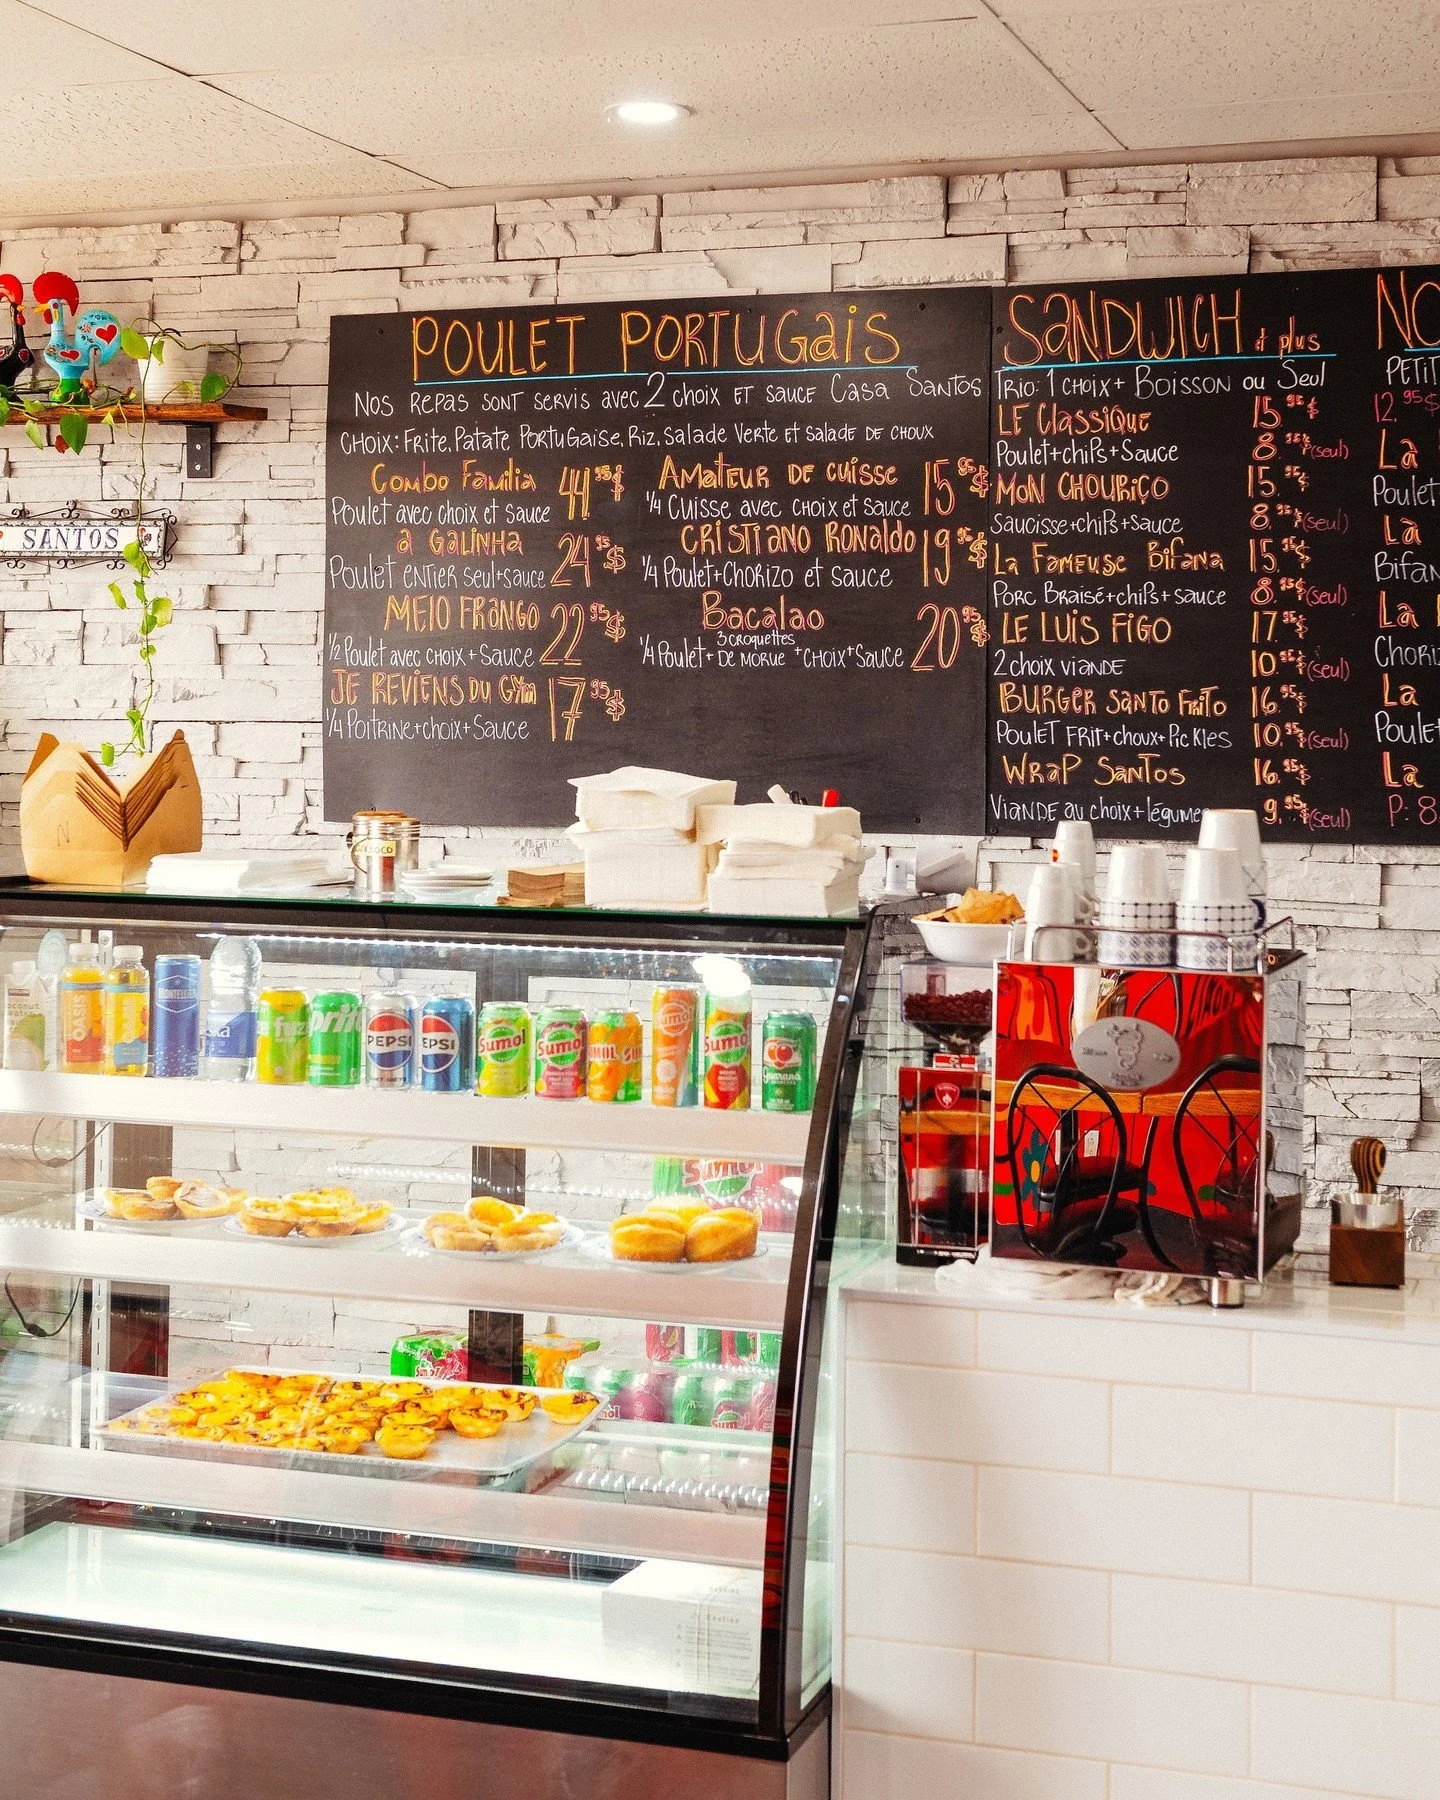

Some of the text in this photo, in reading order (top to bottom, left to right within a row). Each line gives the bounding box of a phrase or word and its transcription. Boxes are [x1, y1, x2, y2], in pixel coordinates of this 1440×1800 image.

[412, 315, 586, 381] POULET
[1279, 315, 1320, 360] plus
[601, 389, 639, 409] avec
[644, 371, 665, 408] 2
[673, 383, 720, 407] choix
[831, 373, 890, 403] Casa
[1243, 377, 1265, 390] ou
[1278, 360, 1326, 389] Seul
[1379, 429, 1419, 469] La
[558, 466, 591, 520] 44
[923, 459, 956, 516] 15
[332, 496, 392, 525] Poulet
[396, 503, 432, 524] avec
[438, 499, 481, 525] choix
[483, 498, 499, 524] et
[740, 499, 782, 518] avec
[842, 494, 859, 517] et
[22, 527, 120, 550] SANTOS
[1384, 514, 1422, 546] La
[330, 554, 398, 590] Poulet
[550, 533, 591, 588] 24
[804, 558, 823, 588] et
[923, 529, 951, 587] 19
[994, 543, 1019, 576] La
[1379, 590, 1419, 628] La
[539, 603, 586, 666] 22
[701, 590, 825, 631] Bacalao
[910, 603, 960, 671] 20
[344, 635, 387, 667] Poulet
[390, 648, 421, 667] avec
[993, 649, 1008, 676] 2
[1010, 650, 1056, 676] choix
[1383, 673, 1418, 706] La
[548, 677, 586, 742] 17
[1383, 751, 1424, 788] La
[1064, 802, 1084, 820] au
[367, 1035, 412, 1048] PEPSI
[479, 1028, 526, 1053] Sumol
